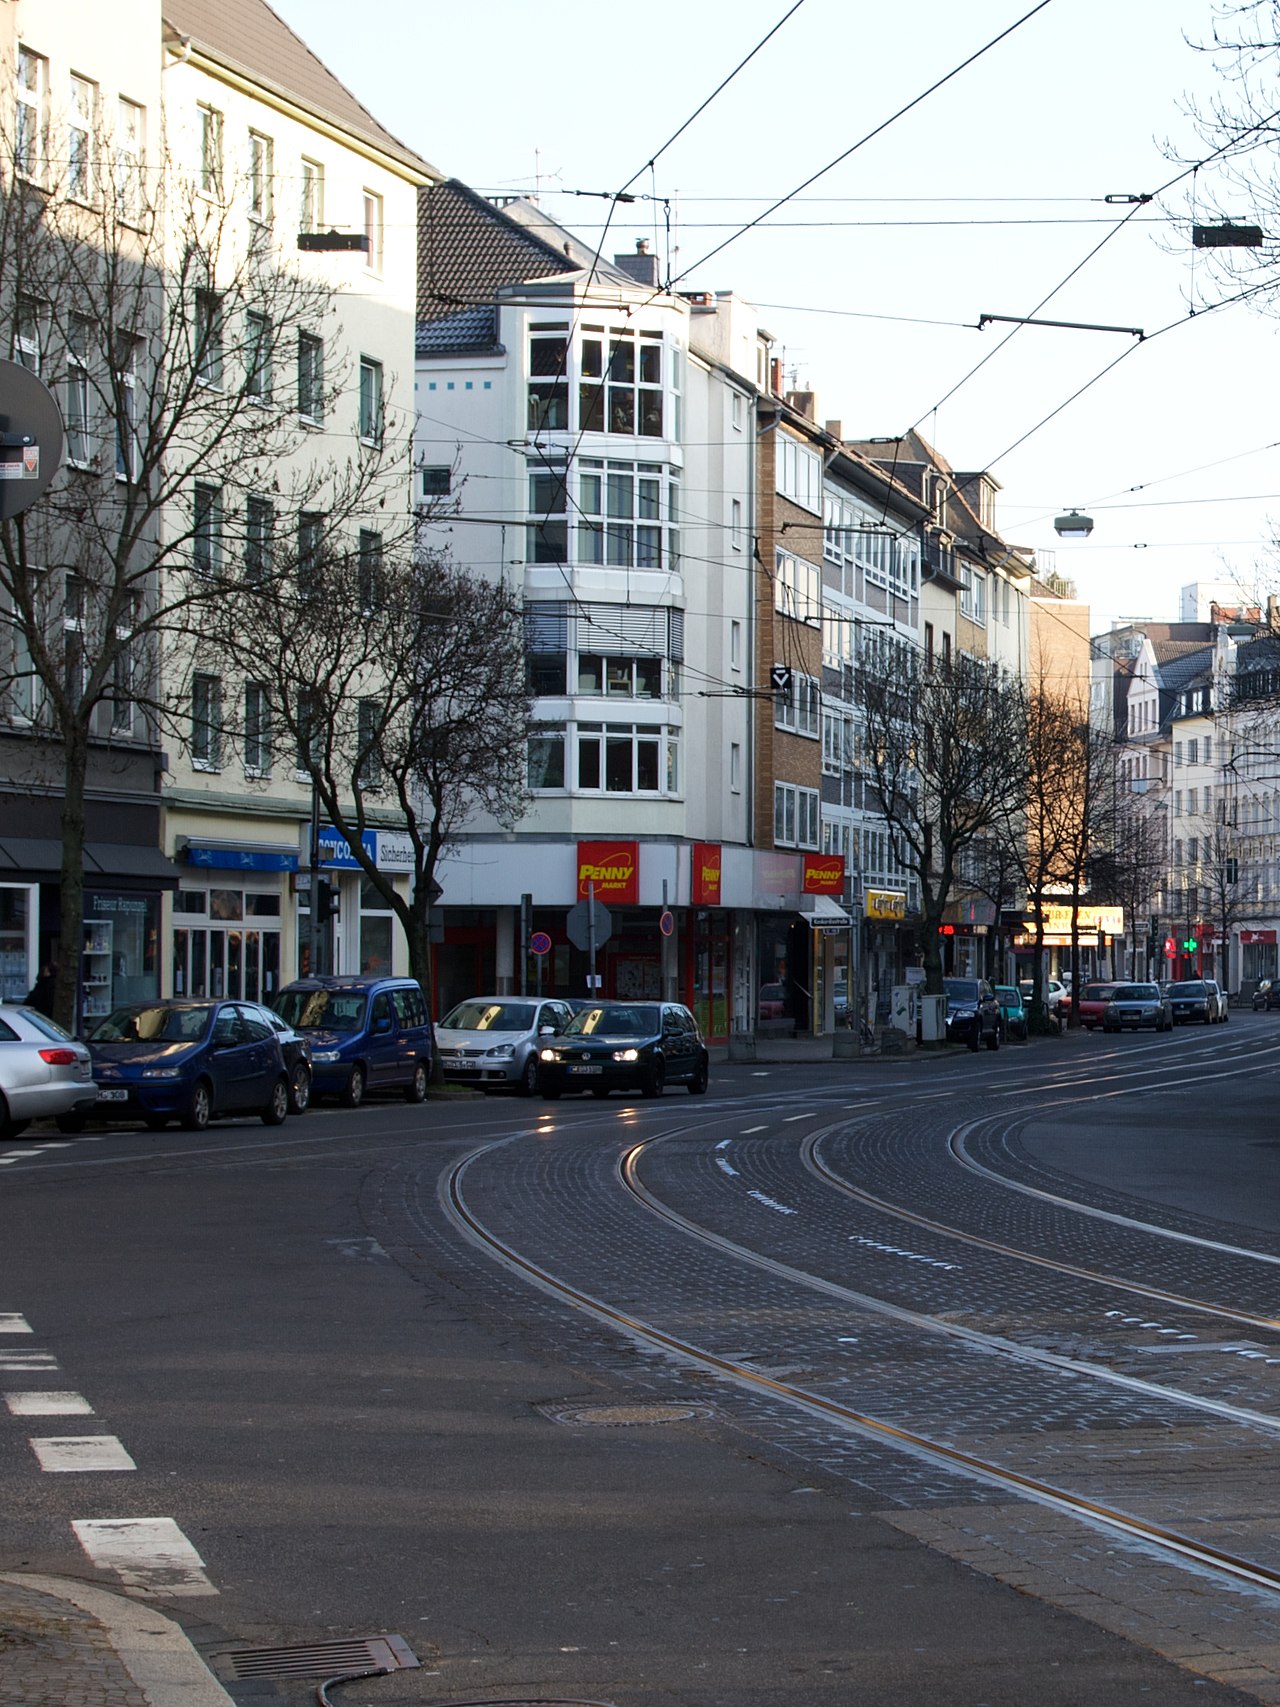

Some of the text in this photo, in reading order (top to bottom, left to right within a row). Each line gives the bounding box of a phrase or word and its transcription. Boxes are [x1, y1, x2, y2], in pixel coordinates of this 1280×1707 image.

[579, 864, 633, 880] PENNY
[701, 866, 720, 881] PENNY
[805, 868, 842, 880] PENNY
